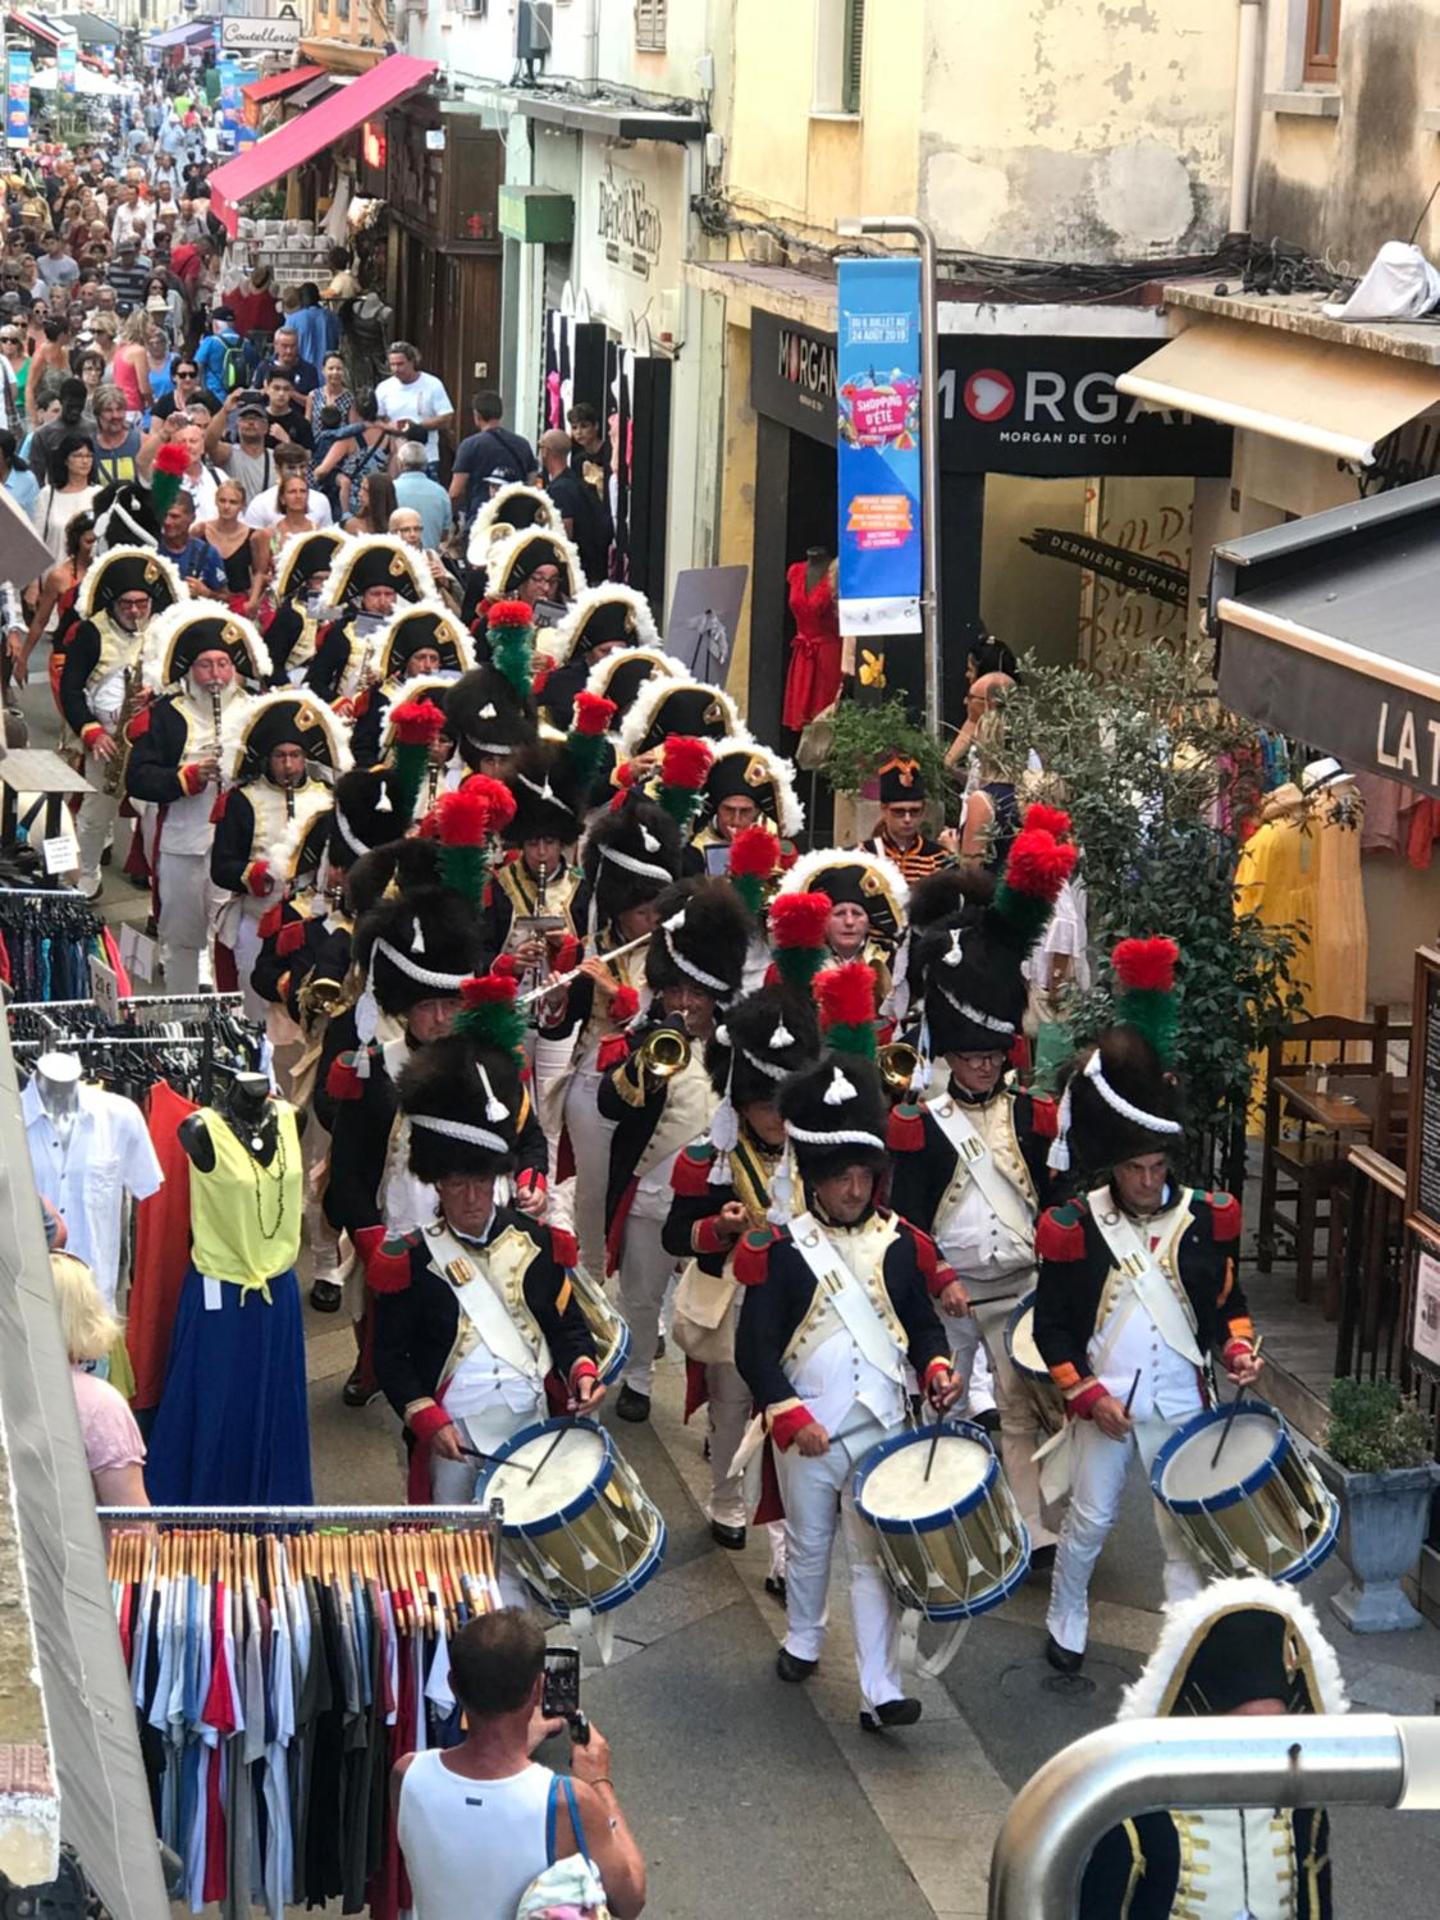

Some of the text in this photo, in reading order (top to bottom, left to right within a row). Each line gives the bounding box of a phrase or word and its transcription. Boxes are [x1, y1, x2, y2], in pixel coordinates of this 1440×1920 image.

[223, 23, 299, 43] Coutellerie
[856, 395, 902, 413] SHOPPING
[1000, 431, 1062, 443] MORGAN
[1068, 433, 1087, 444] DE
[1094, 433, 1117, 445] TOI
[1377, 701, 1419, 778] LA
